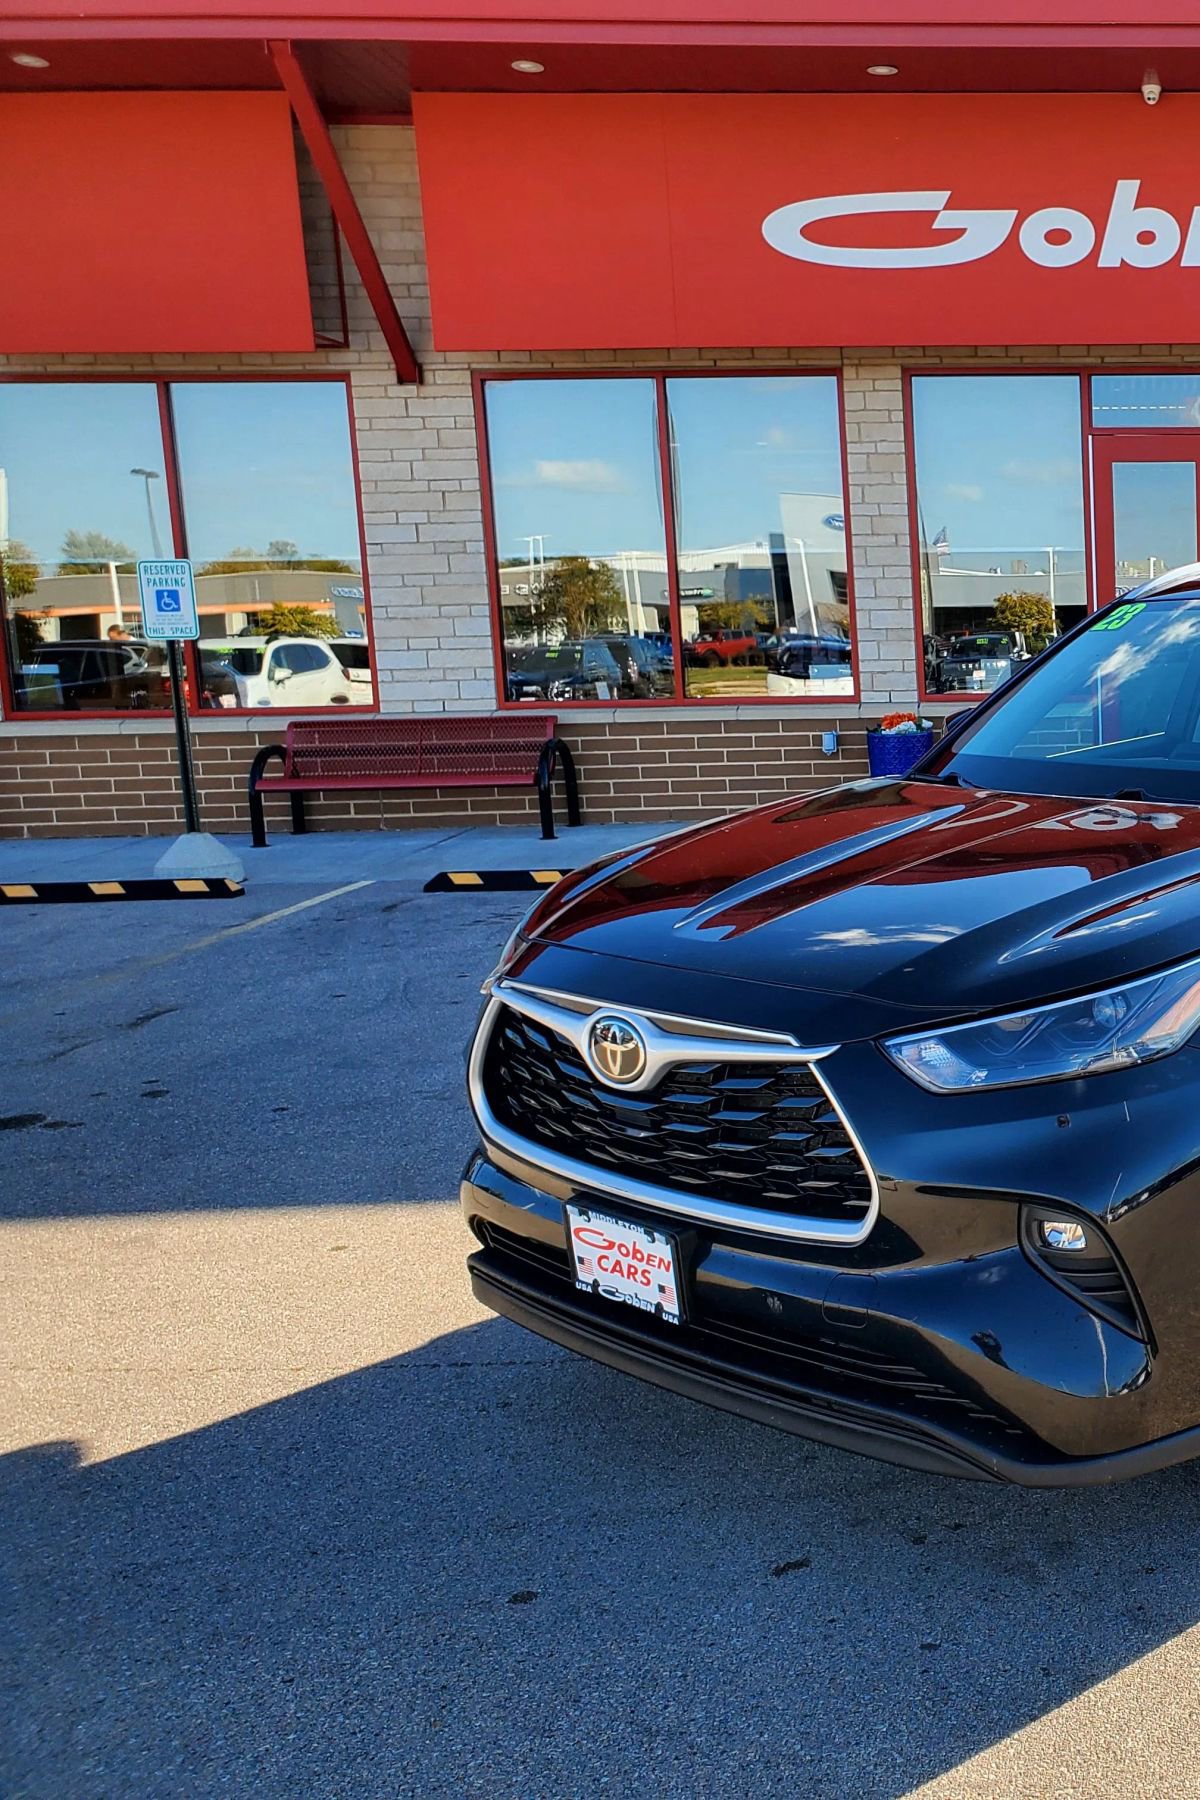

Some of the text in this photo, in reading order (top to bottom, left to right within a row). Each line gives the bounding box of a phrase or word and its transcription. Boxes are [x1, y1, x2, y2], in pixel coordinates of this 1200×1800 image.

[143, 564, 186, 575] RESERVED
[147, 577, 186, 587] PARKING
[1090, 603, 1147, 631] 23
[148, 626, 194, 635] THIS SPACE
[589, 1211, 645, 1235] MIDDLETON
[596, 1254, 652, 1287] CARS
[575, 1281, 593, 1293] USA
[662, 1313, 680, 1325] USA
